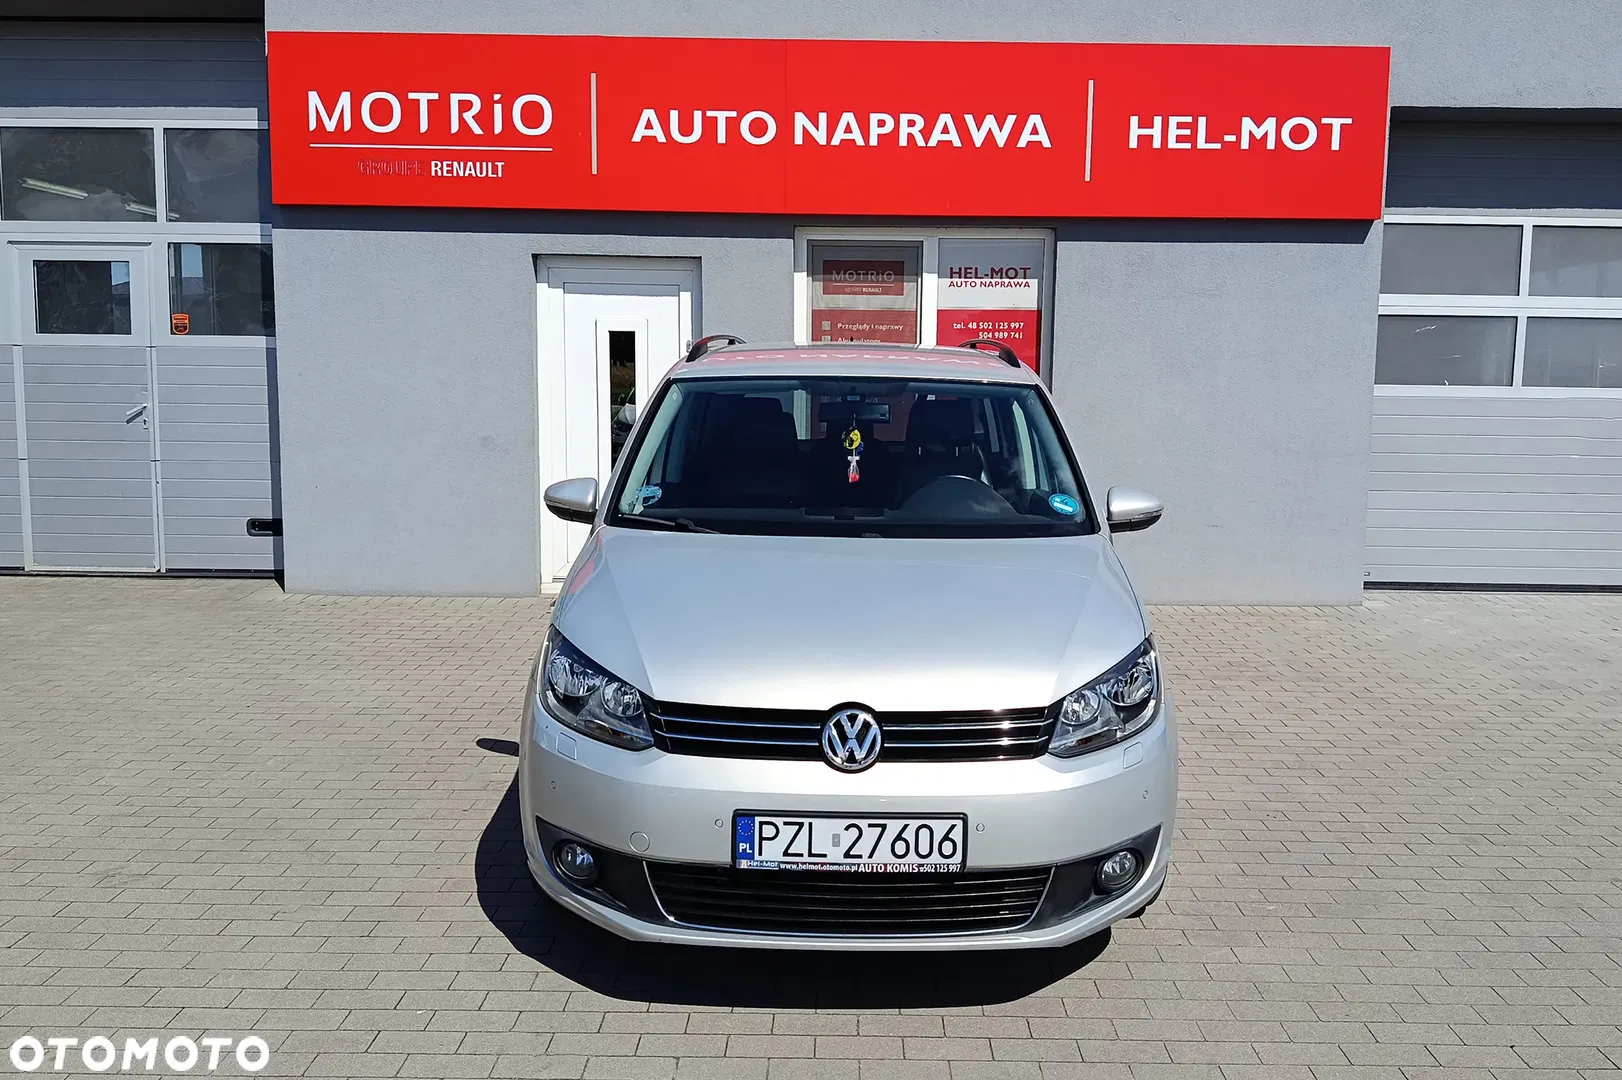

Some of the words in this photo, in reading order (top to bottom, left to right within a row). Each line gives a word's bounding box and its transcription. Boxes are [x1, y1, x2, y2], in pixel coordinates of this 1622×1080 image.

[631, 108, 777, 146] AUTO
[793, 112, 1052, 149] NAPRAWA
[1128, 115, 1353, 151] HEL-MOT
[431, 160, 504, 177] RENAULT
[949, 266, 1031, 280] HEL-MOT
[739, 843, 752, 853] PL
[758, 820, 828, 858] PZL
[843, 822, 958, 860] 27606
[780, 862, 858, 872] www.helmot.otomoto.pl
[858, 863, 885, 872] AUTO
[886, 863, 919, 872] KOMIS
[936, 864, 948, 872] 125
[949, 864, 960, 872] 997
